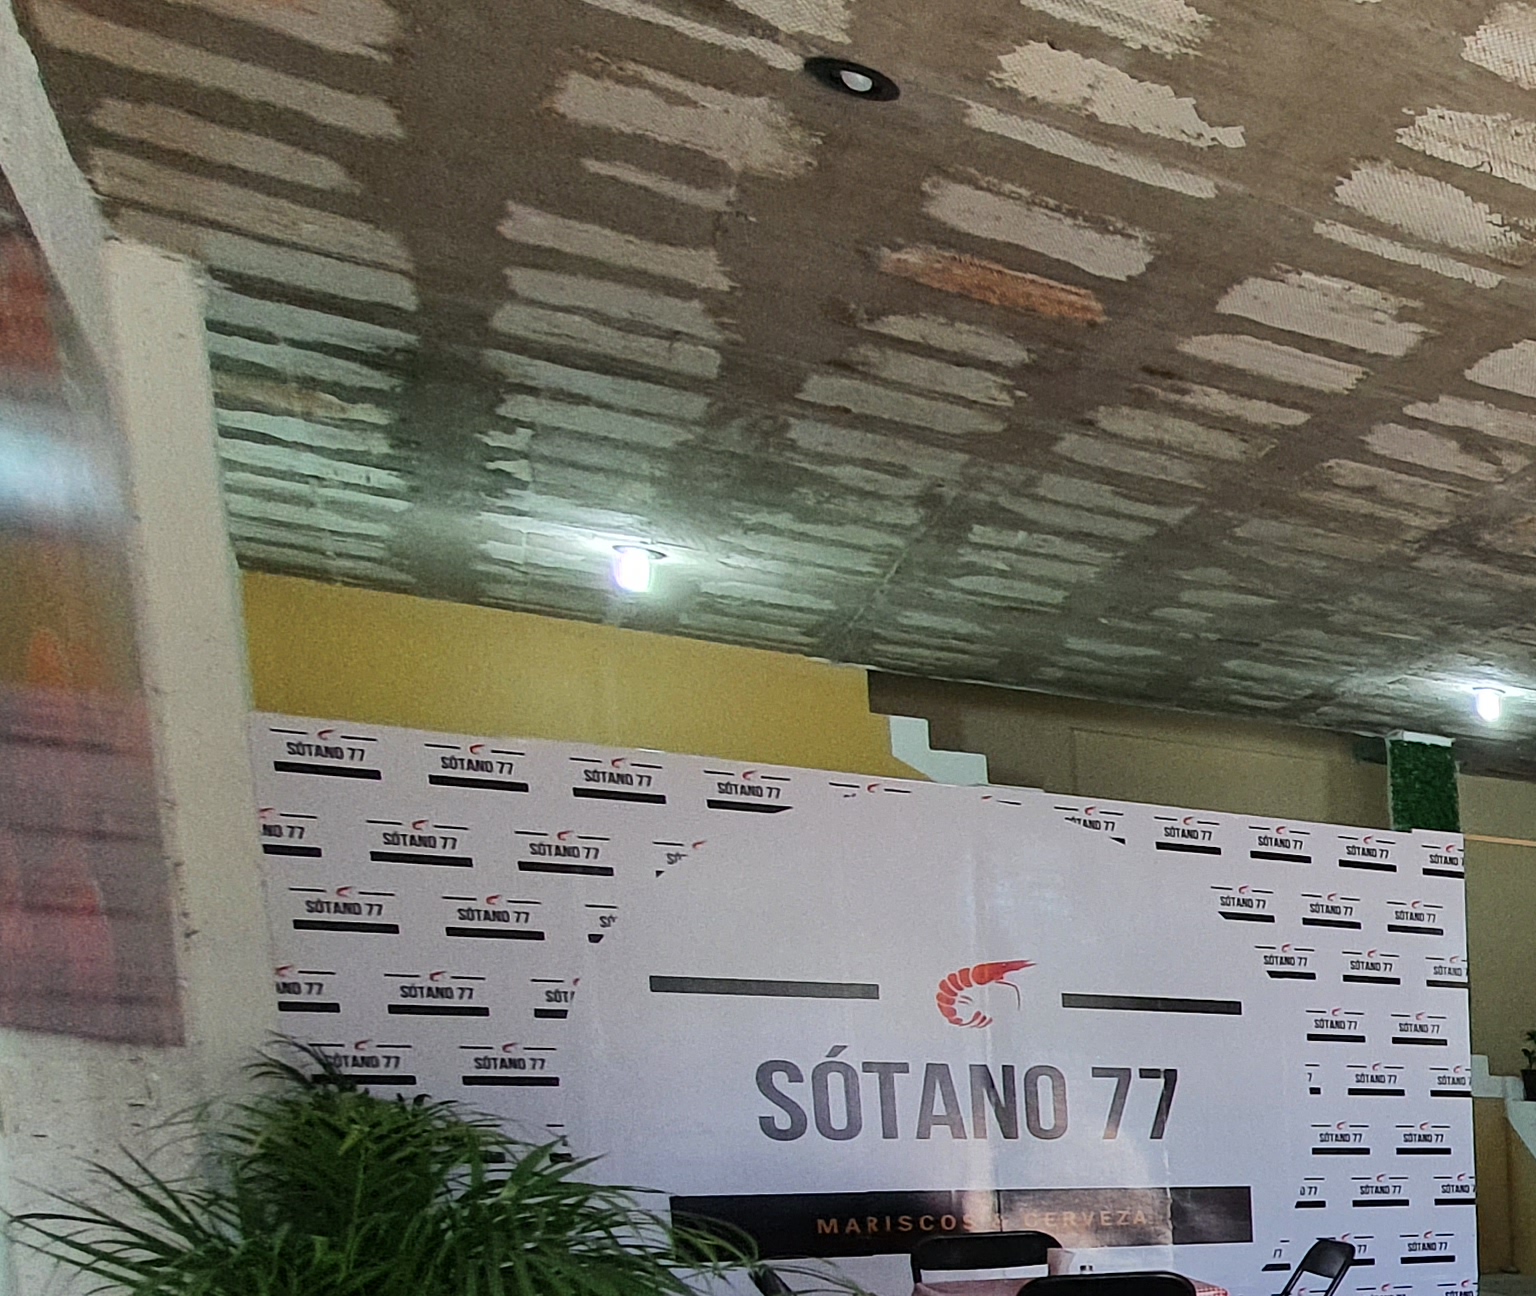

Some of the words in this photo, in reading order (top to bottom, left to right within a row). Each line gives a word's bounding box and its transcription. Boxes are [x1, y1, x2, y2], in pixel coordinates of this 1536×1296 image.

[286, 741, 345, 760] SÓTANO
[347, 747, 366, 762] 77
[441, 755, 494, 774] SÓTANO
[496, 761, 514, 776] 77
[584, 769, 634, 786] SÓTANO
[636, 774, 653, 788] 77
[717, 781, 764, 798] SÓTANO
[766, 787, 781, 800] 77
[286, 825, 306, 840] 77
[1104, 821, 1116, 832] 77
[1164, 826, 1199, 840] SÓTANO
[1201, 830, 1213, 841] 77
[383, 831, 437, 849] SÓTANO
[440, 837, 458, 850] 77
[1258, 836, 1291, 850] SÓTANO
[1292, 840, 1304, 851] 77
[529, 843, 581, 859] SÓTANO
[582, 847, 600, 860] 77
[1346, 845, 1378, 858] SÓTANO
[1379, 849, 1390, 860] 77
[1429, 854, 1459, 867] SÓTANO
[305, 899, 363, 916] SÓTANO
[365, 903, 384, 917] 77
[1220, 896, 1254, 909] SÓTANO
[1255, 899, 1267, 910] 77
[1310, 903, 1342, 916] SÓTANO
[1343, 906, 1354, 917] 77
[457, 907, 511, 923] SÓTANO
[513, 911, 530, 924] 77
[1395, 910, 1425, 922] SÓTANO
[1426, 913, 1437, 924] 77
[1264, 955, 1296, 967] SÓTANO
[1297, 957, 1308, 967] 77
[1350, 960, 1382, 972] SÓTANO
[1383, 962, 1393, 973] 77
[1434, 965, 1463, 977] SÓTANO
[302, 983, 323, 996] 77
[400, 984, 453, 1000] SÓTANO
[457, 987, 475, 1001] 77
[1314, 1018, 1346, 1030] SÓTANO
[1347, 1020, 1358, 1031] 77
[1399, 1023, 1429, 1034] SÓTANO
[1431, 1024, 1441, 1035] 77
[382, 1056, 401, 1070] 77
[474, 1056, 527, 1071] SÓTANO
[529, 1058, 546, 1071] 77
[1355, 1073, 1386, 1084] SÓTANO
[1387, 1075, 1398, 1085] 77
[1437, 1075, 1467, 1086] SÓTANO
[755, 1045, 1067, 1141] SÓTANO
[1092, 1067, 1177, 1139] 77
[1319, 1132, 1351, 1143] SÓTANO
[1352, 1133, 1363, 1143] 77
[1403, 1133, 1433, 1143] SÓTANO
[1434, 1134, 1445, 1143] 77
[1308, 1186, 1318, 1196] 77
[1360, 1185, 1391, 1196] SÓTANO
[1392, 1185, 1402, 1195] 77
[1441, 1184, 1471, 1194] SÓTANO
[815, 1215, 974, 1236] MARISCOS
[1023, 1209, 1148, 1228] CERVEZA
[1408, 1242, 1437, 1253] SÓTANO
[1438, 1242, 1448, 1251] 77
